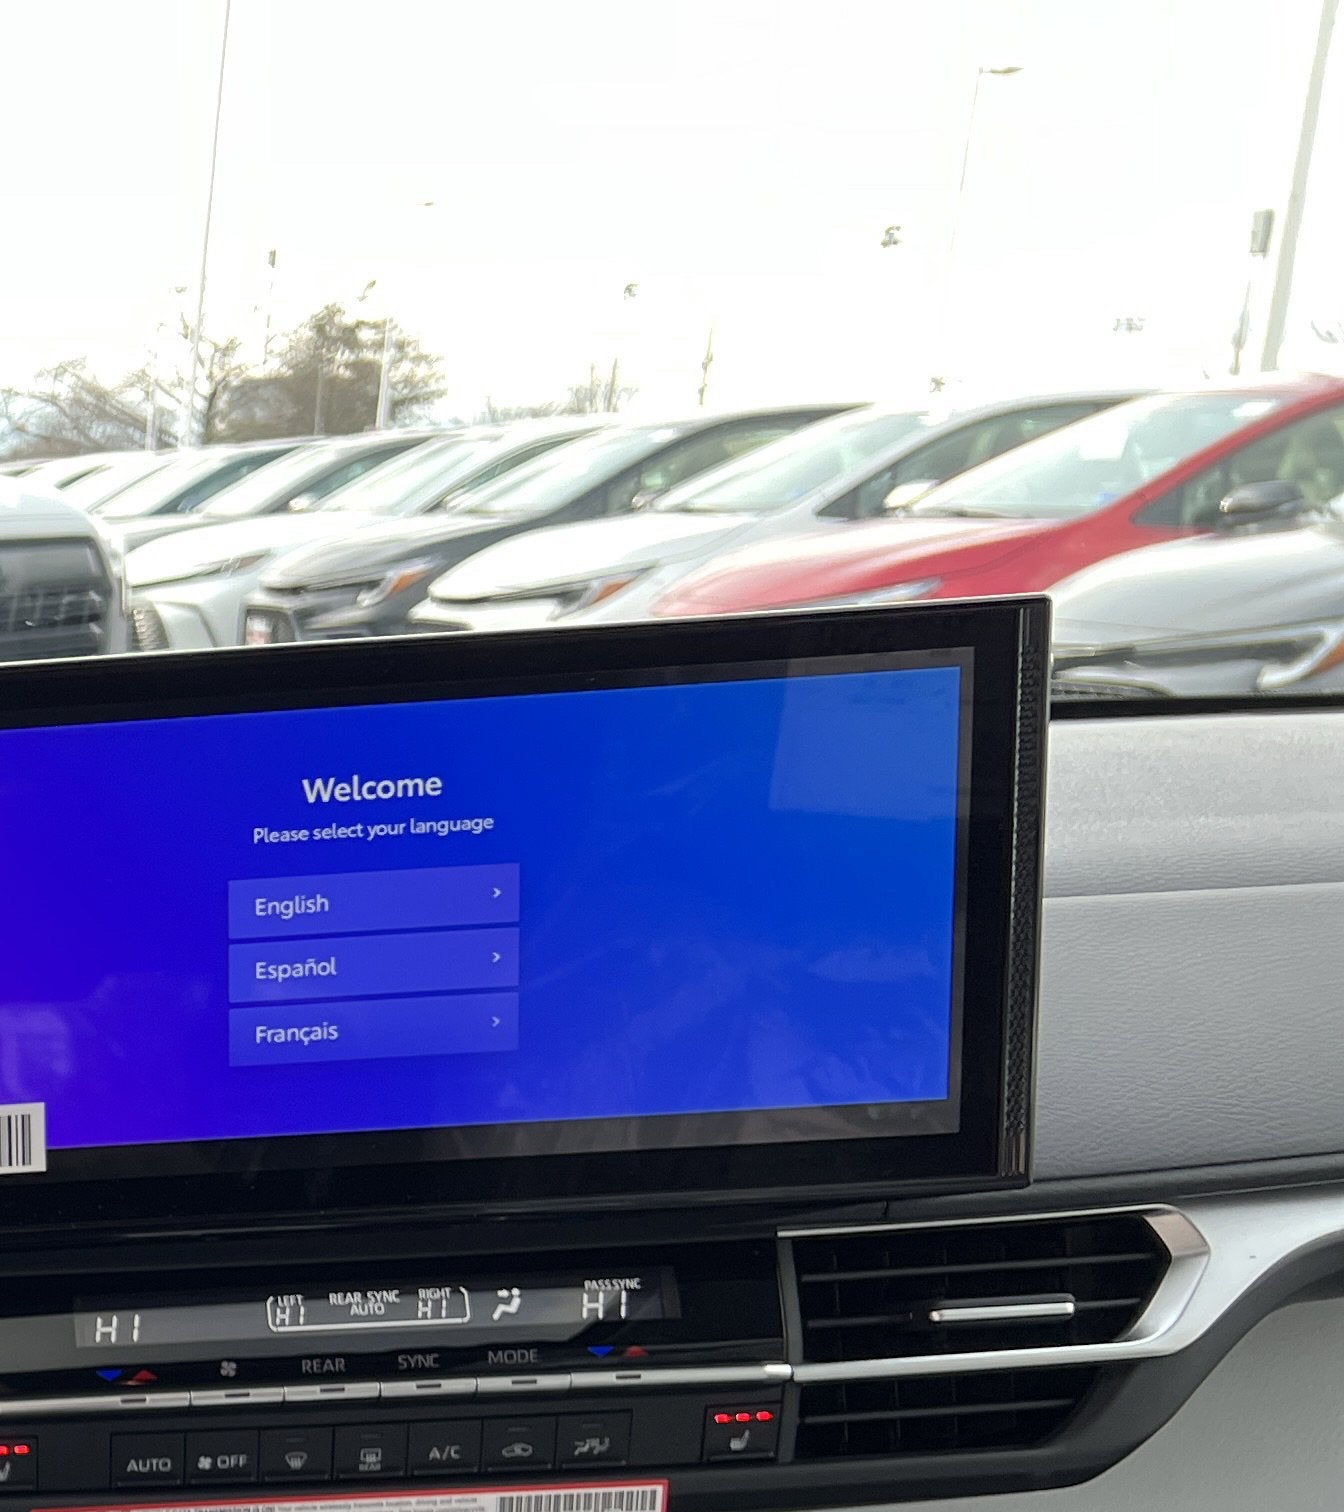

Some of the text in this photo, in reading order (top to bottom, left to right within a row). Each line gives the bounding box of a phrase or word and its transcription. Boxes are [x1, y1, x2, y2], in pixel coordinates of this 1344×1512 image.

[301, 774, 443, 804] Welcome
[253, 817, 494, 844] Please select your language
[254, 894, 330, 920] English
[255, 957, 337, 982] Español
[255, 1022, 339, 1046] Français
[584, 1278, 641, 1290] PASS SYNC
[277, 1294, 304, 1307] LEFT
[329, 1289, 400, 1305] REAR SYNC
[418, 1287, 452, 1300] RIGHT
[350, 1302, 385, 1316] AUTO
[398, 1353, 439, 1369] SYNC
[487, 1349, 539, 1365] MODE
[302, 1357, 346, 1374] REAR
[428, 1445, 461, 1461] A/C
[126, 1458, 172, 1473] AUTO
[217, 1455, 247, 1470] OFF
